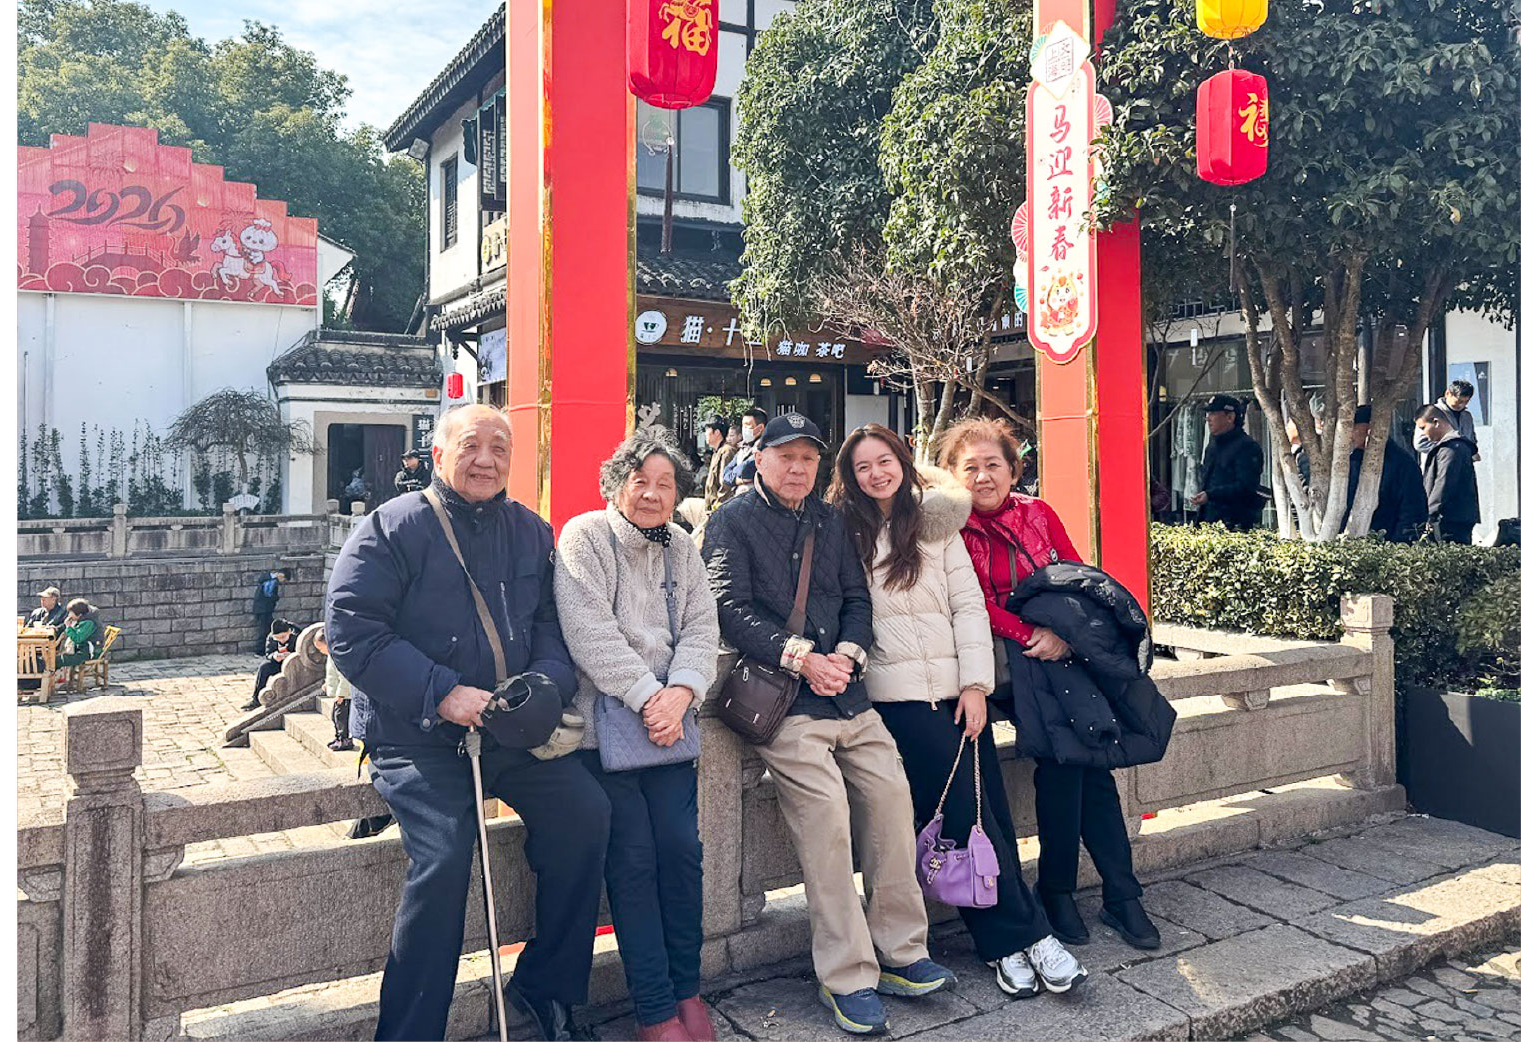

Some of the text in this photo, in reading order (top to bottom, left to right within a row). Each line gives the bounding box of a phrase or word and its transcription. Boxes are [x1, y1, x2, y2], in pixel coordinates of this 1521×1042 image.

[1238, 92, 1269, 148] 福
[47, 179, 185, 236] 2026
[1046, 104, 1075, 261] 马迎新春
[776, 340, 847, 359] 猫咖 茶吧
